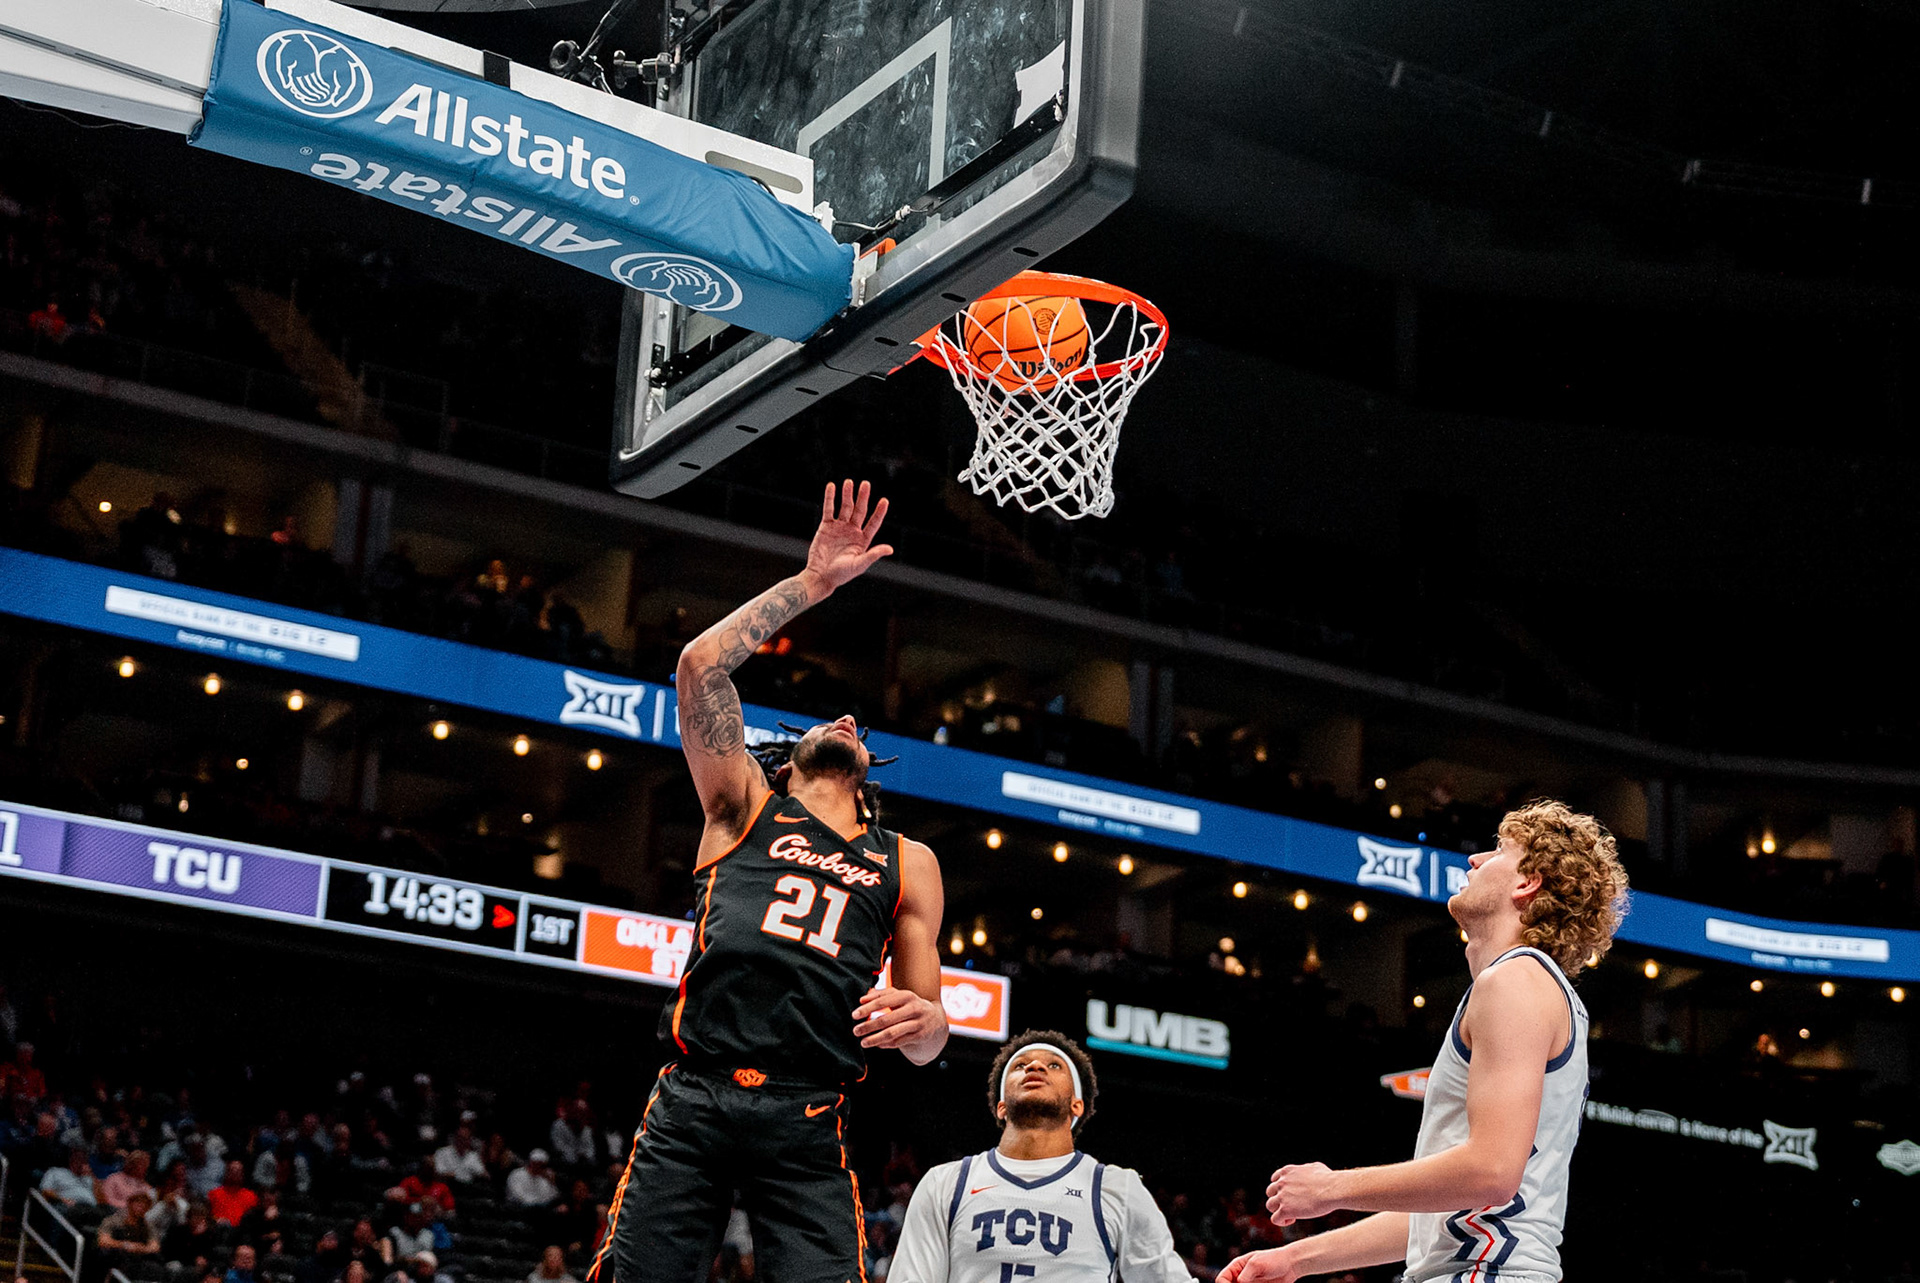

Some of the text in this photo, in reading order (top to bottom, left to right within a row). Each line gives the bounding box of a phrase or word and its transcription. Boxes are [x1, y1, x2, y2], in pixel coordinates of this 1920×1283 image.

[374, 83, 626, 199] Allstate
[310, 153, 623, 254] Allstate
[147, 841, 242, 895] TCU
[768, 833, 882, 886] Cowboys
[363, 871, 484, 931] 14:33
[529, 913, 576, 945] 1ST
[760, 874, 851, 958] 21
[1086, 999, 1231, 1057] UMB
[971, 1208, 1073, 1257] TCU
